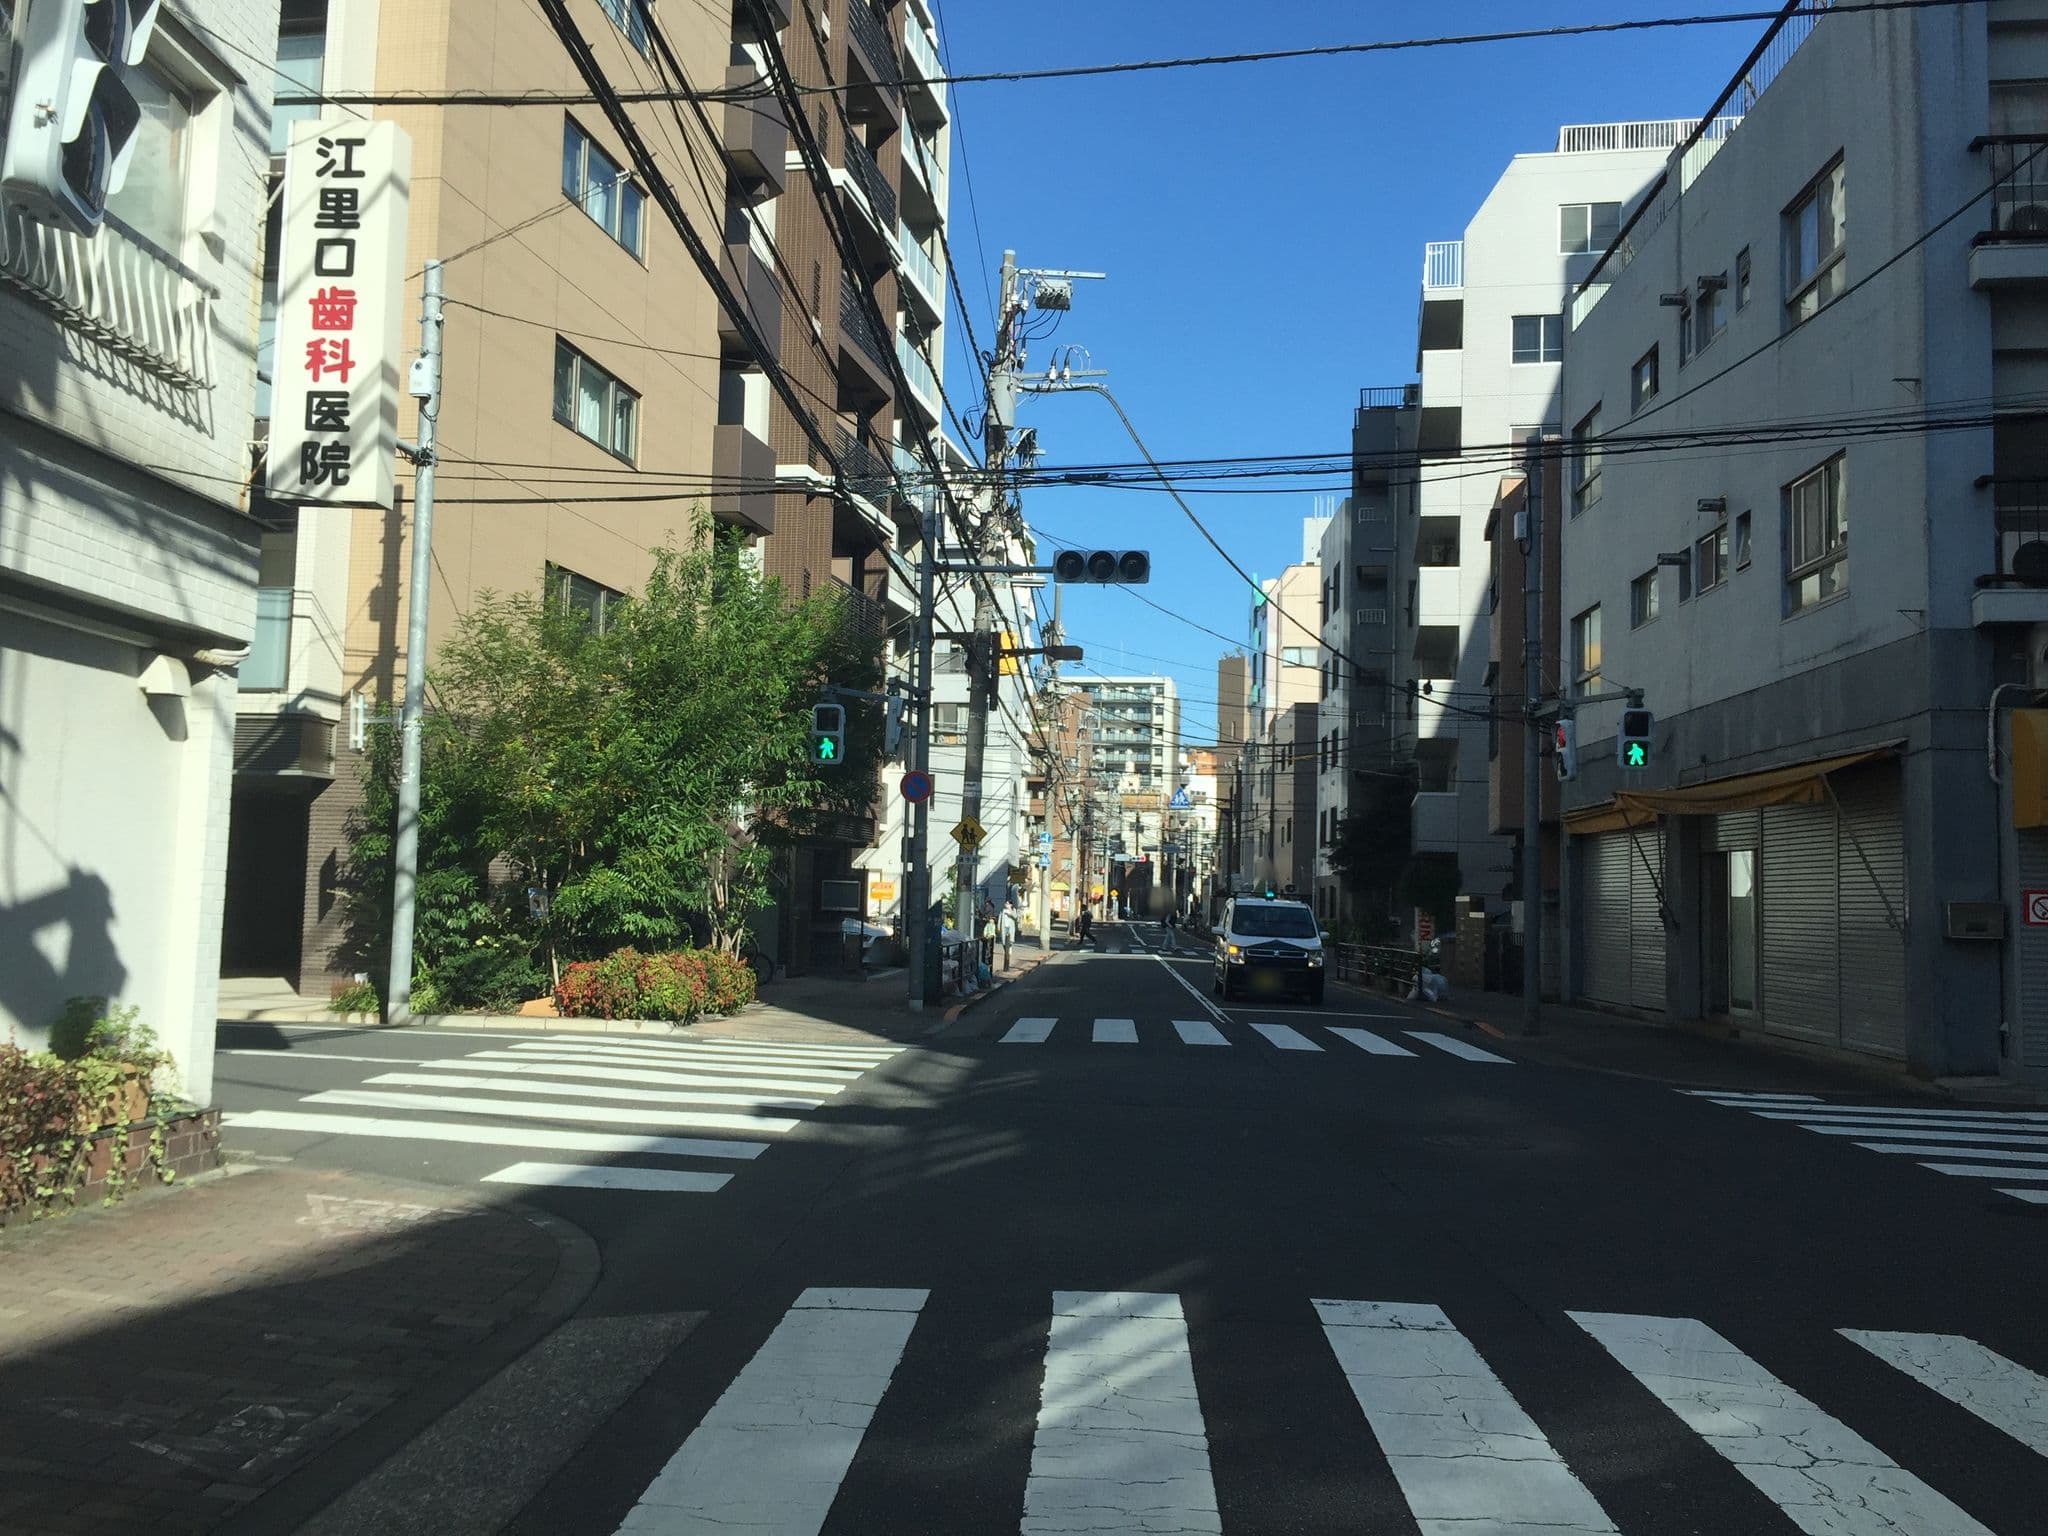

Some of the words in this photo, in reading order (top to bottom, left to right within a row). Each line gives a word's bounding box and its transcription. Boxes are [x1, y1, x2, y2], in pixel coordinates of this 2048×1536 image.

[299, 136, 367, 487] 江里口歯科医院
